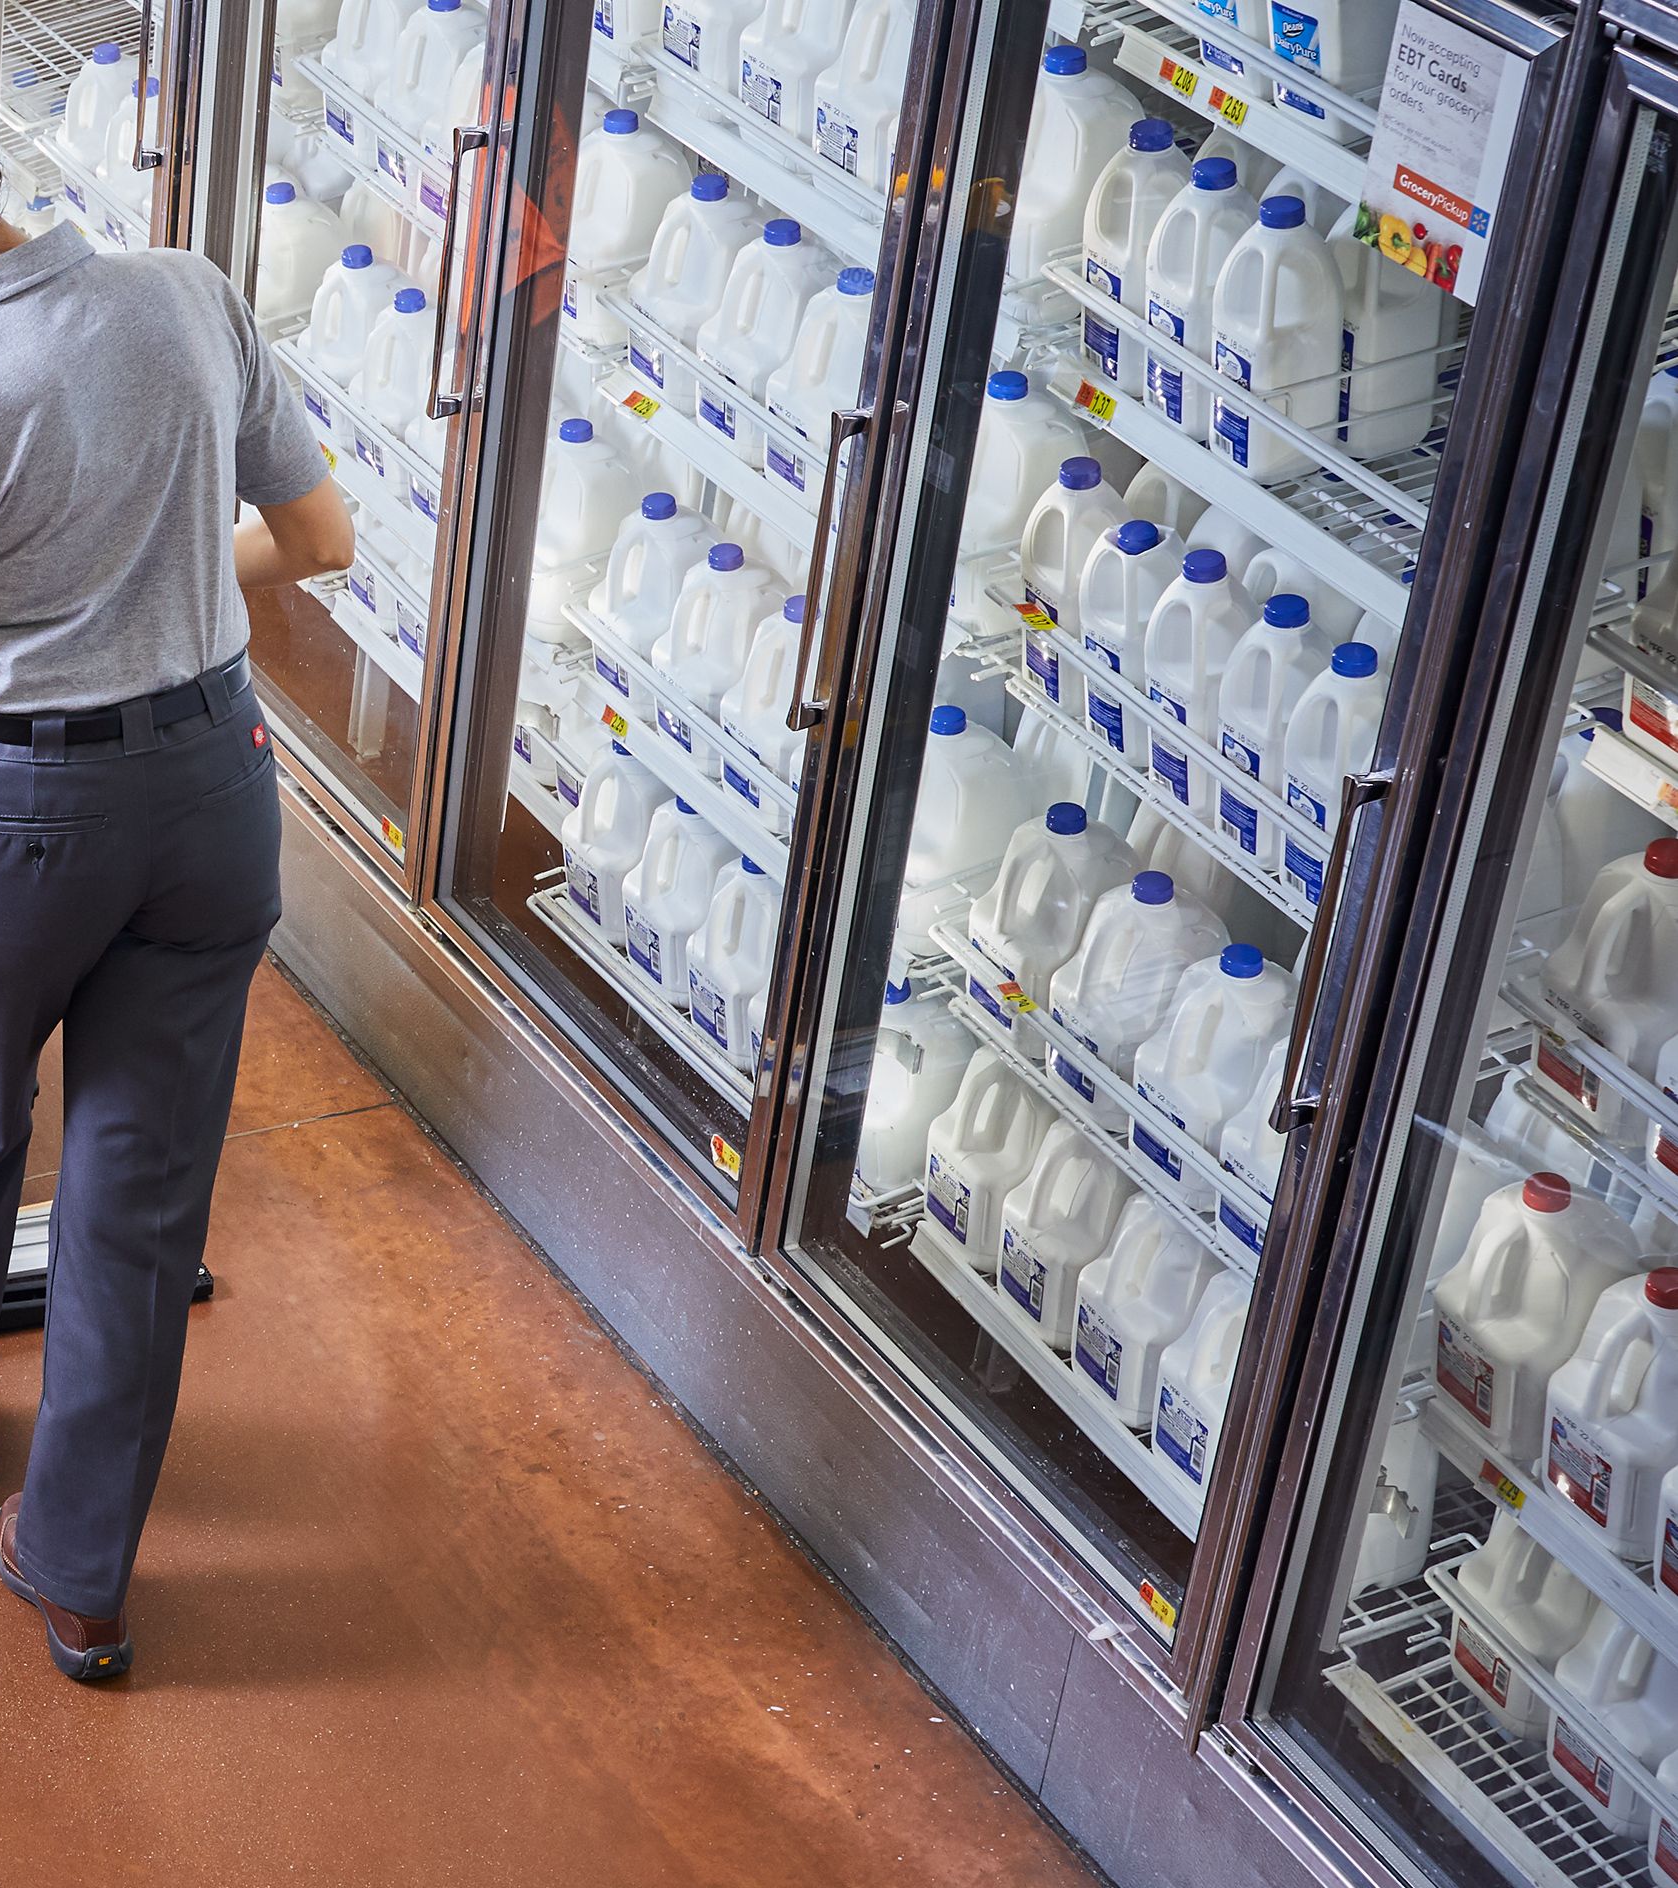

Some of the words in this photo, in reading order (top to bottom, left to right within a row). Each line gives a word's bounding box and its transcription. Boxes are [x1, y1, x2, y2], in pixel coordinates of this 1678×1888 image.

[1274, 33, 1317, 60] DairyPure
[1398, 43, 1426, 70] EBT
[1428, 60, 1467, 93] Cards
[1401, 24, 1426, 46] Now
[1428, 41, 1480, 78] accepting
[1389, 87, 1425, 113] orders.
[1393, 65, 1409, 83] for
[1411, 78, 1436, 97] your
[1437, 92, 1480, 123] grocery
[1399, 174, 1470, 222] GroceryPickup
